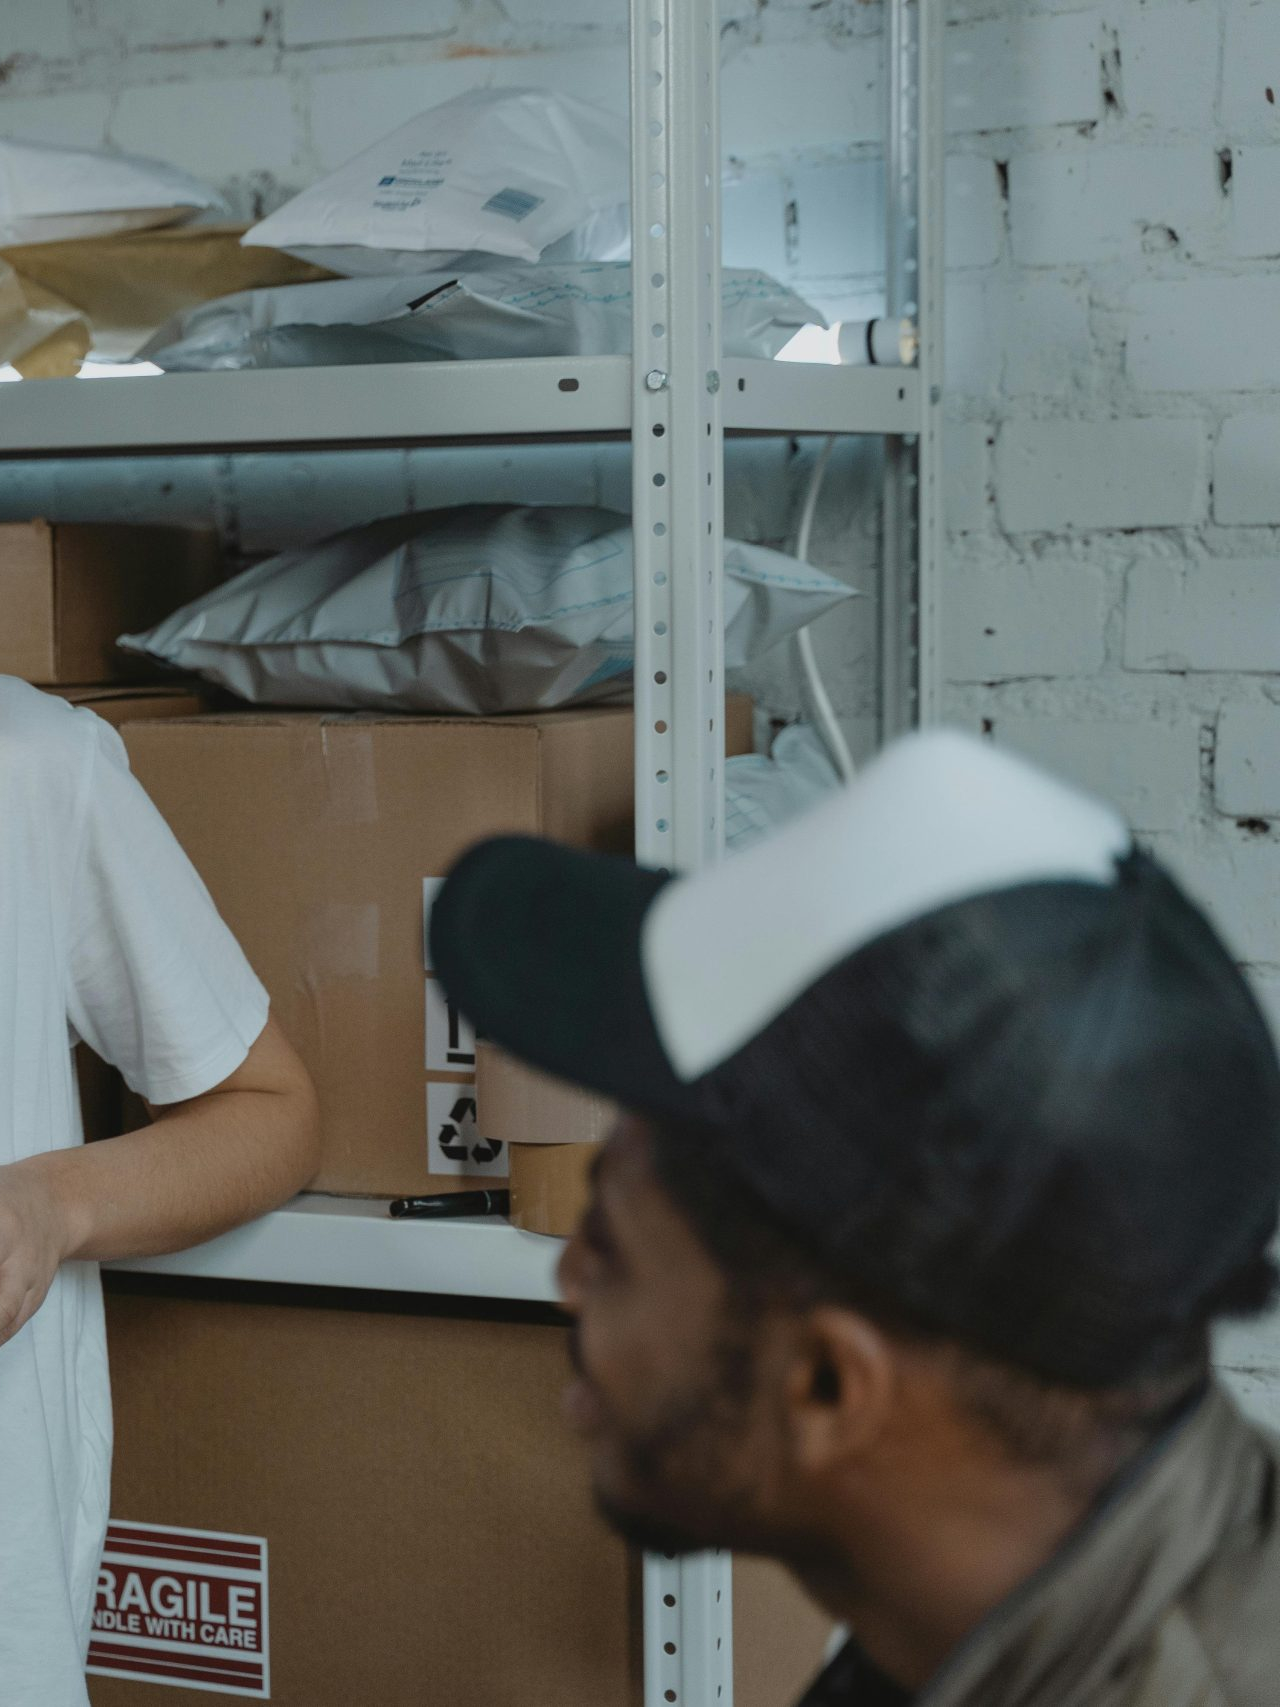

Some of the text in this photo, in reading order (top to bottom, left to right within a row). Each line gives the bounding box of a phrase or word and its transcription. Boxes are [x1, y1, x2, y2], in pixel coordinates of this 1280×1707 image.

[95, 1568, 257, 1628] RAGILE
[91, 1609, 257, 1649] NDLE WITH CARE
